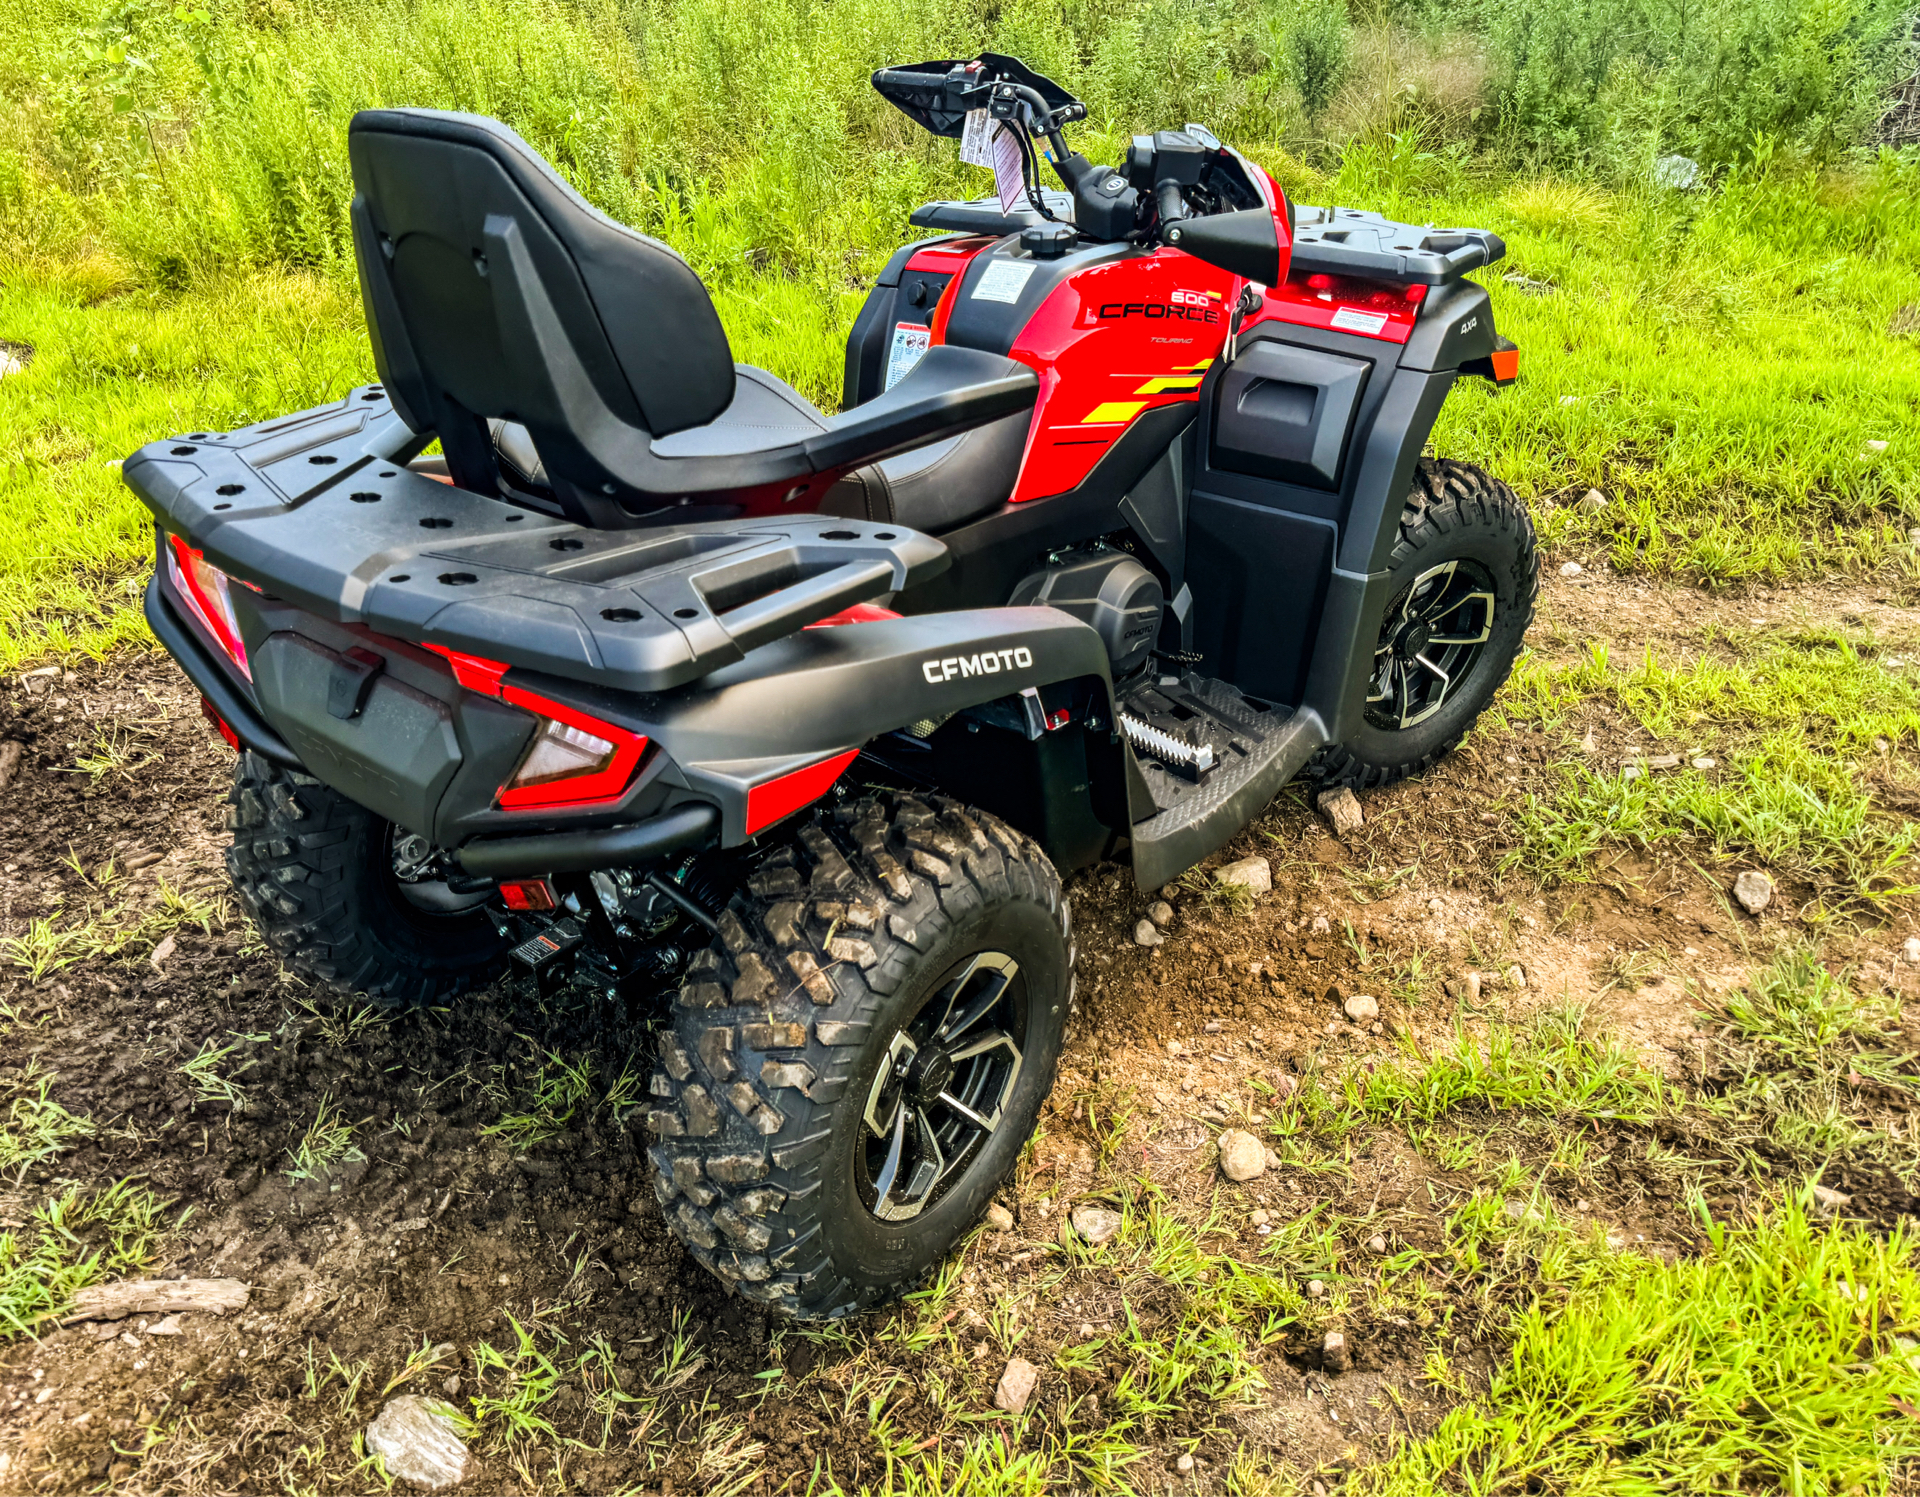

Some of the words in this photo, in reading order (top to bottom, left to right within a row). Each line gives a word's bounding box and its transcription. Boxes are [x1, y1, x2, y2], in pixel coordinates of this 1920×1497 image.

[1171, 291, 1209, 307] 600
[1099, 303, 1218, 324] CFORCE
[1151, 336, 1194, 344] TOURING
[1124, 624, 1153, 639] CFMOTO
[922, 646, 1033, 684] CFMOTO
